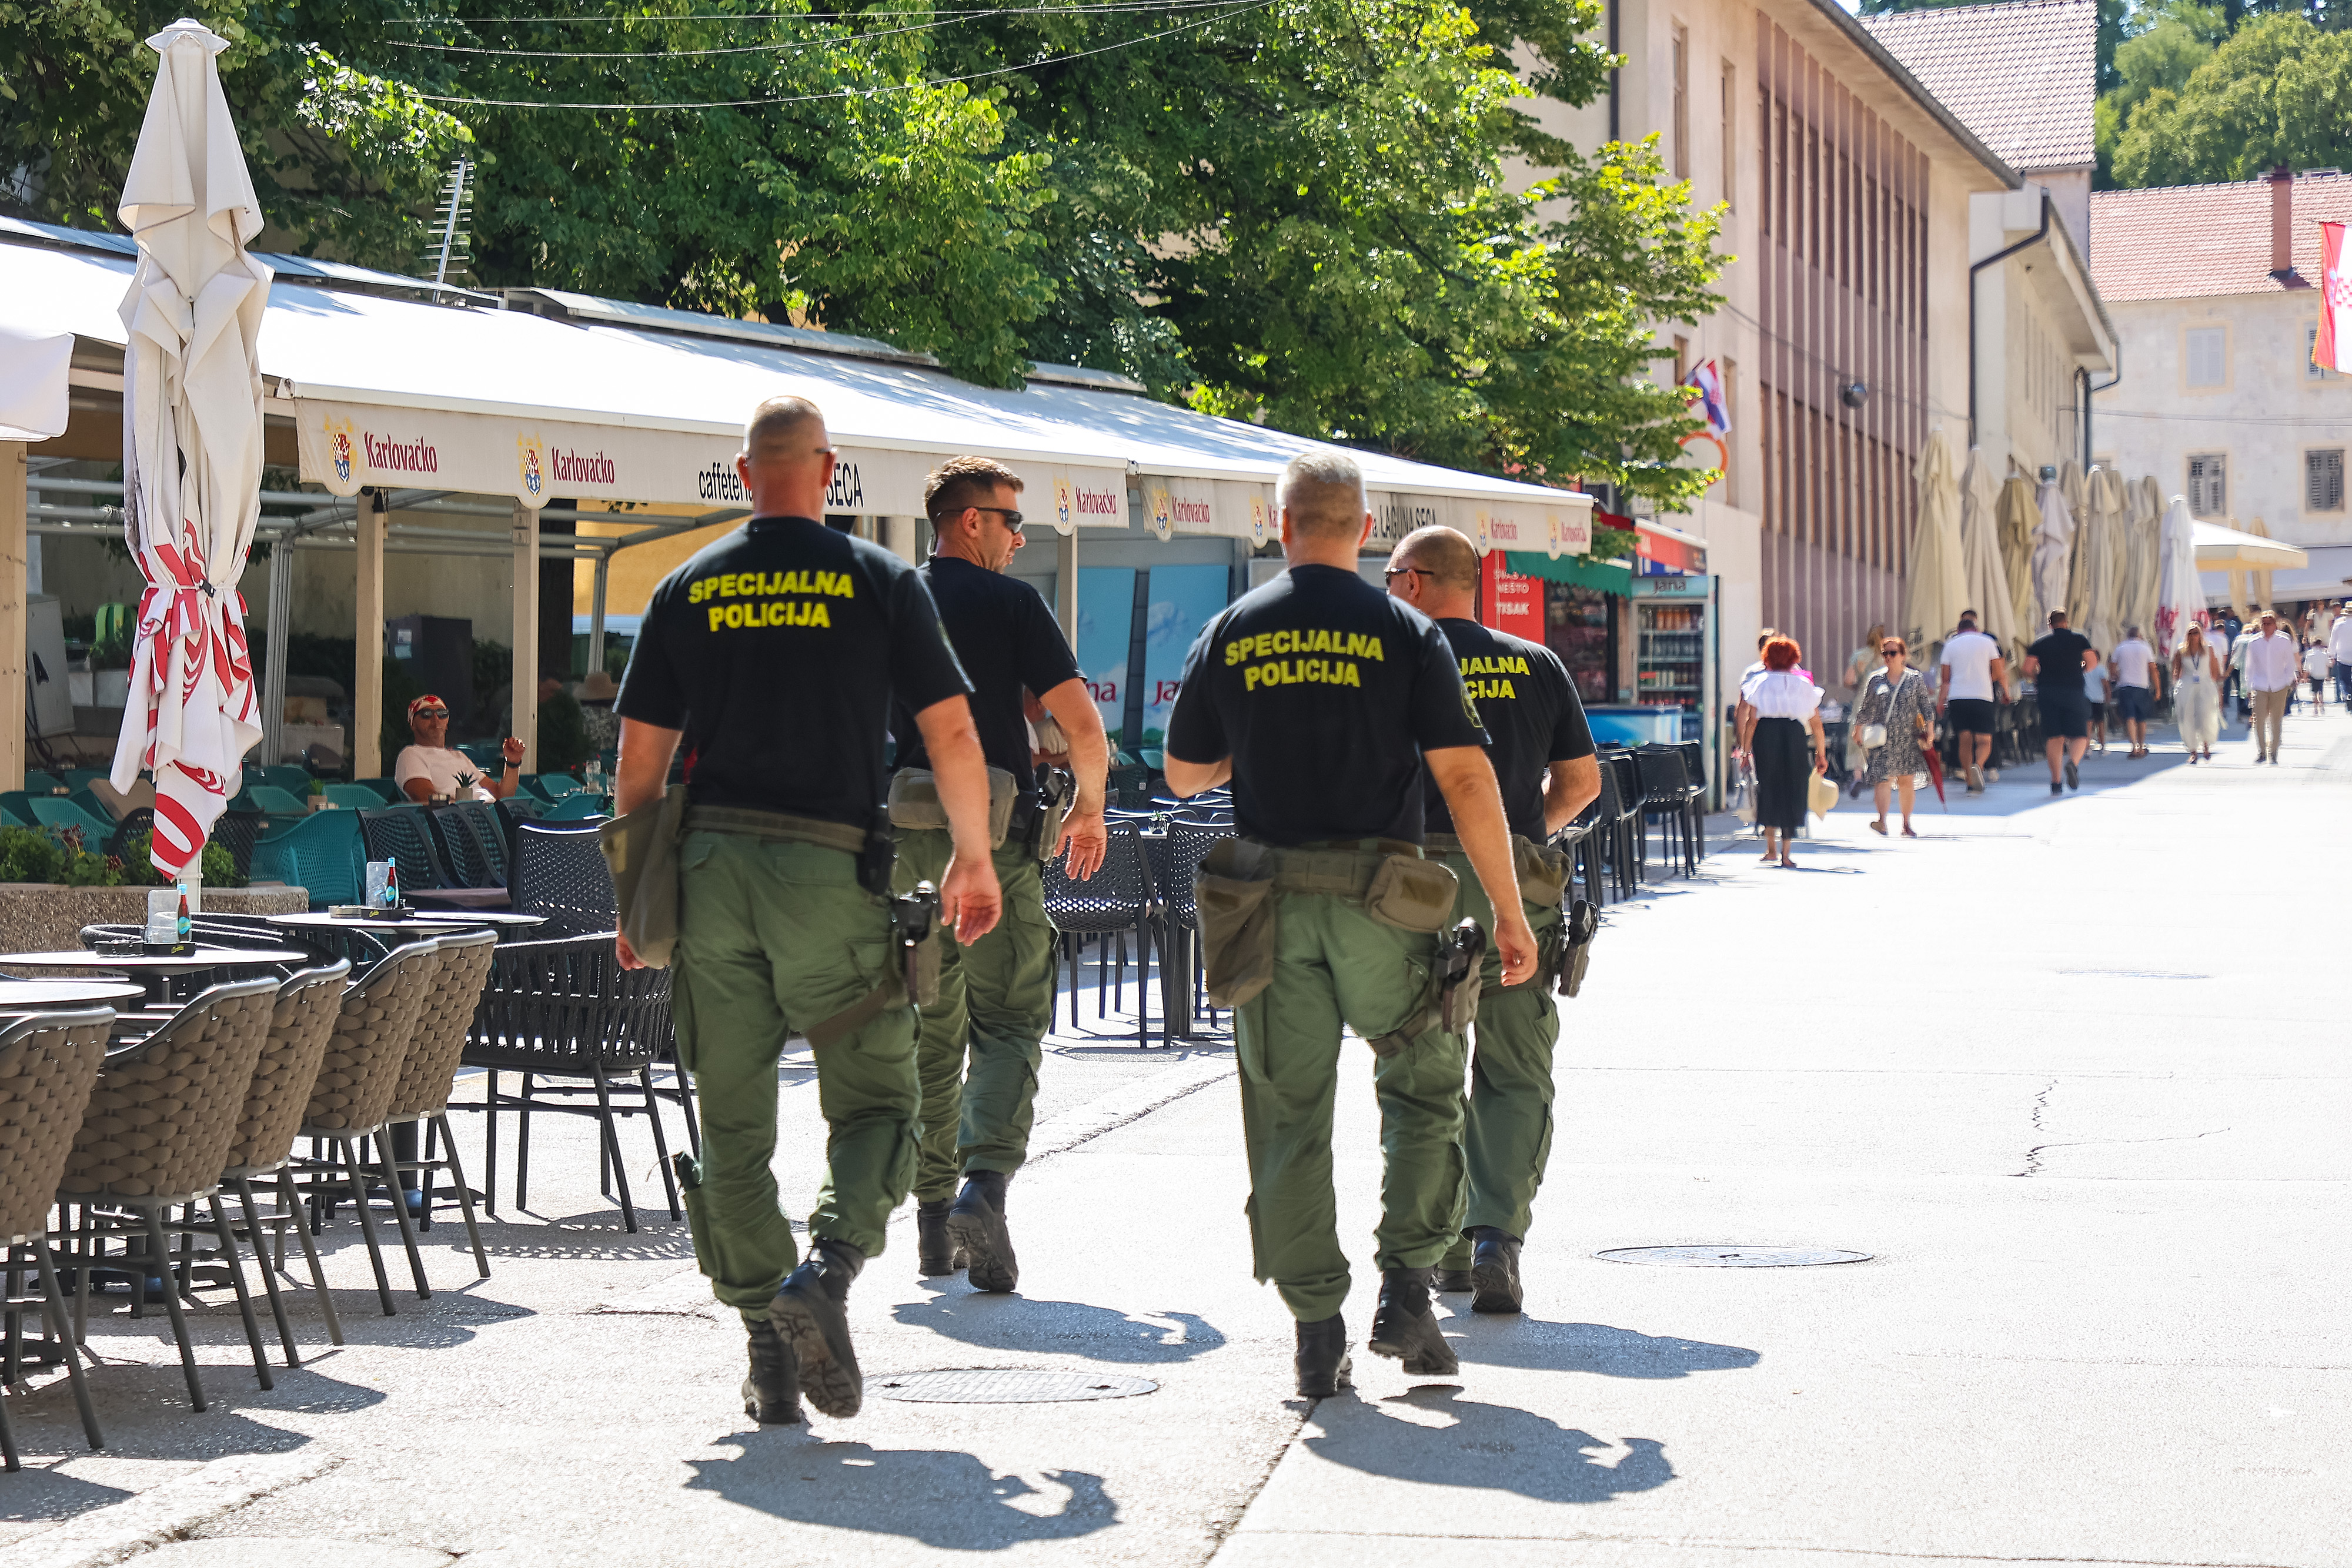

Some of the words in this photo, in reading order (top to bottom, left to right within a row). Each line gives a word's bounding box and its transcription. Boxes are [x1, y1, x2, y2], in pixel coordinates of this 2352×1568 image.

[364, 431, 437, 473] Karlovačko
[552, 446, 615, 484] Karlovačko
[699, 462, 753, 502] caffete
[687, 570, 854, 604] SPECIJALNA
[707, 600, 831, 632] POLICIJA
[1224, 629, 1385, 667] SPECIJALNA
[1244, 658, 1361, 692] POLICIJA
[1458, 656, 1531, 676] JALNA
[1085, 681, 1117, 703] na
[1465, 680, 1516, 700] CIJA
